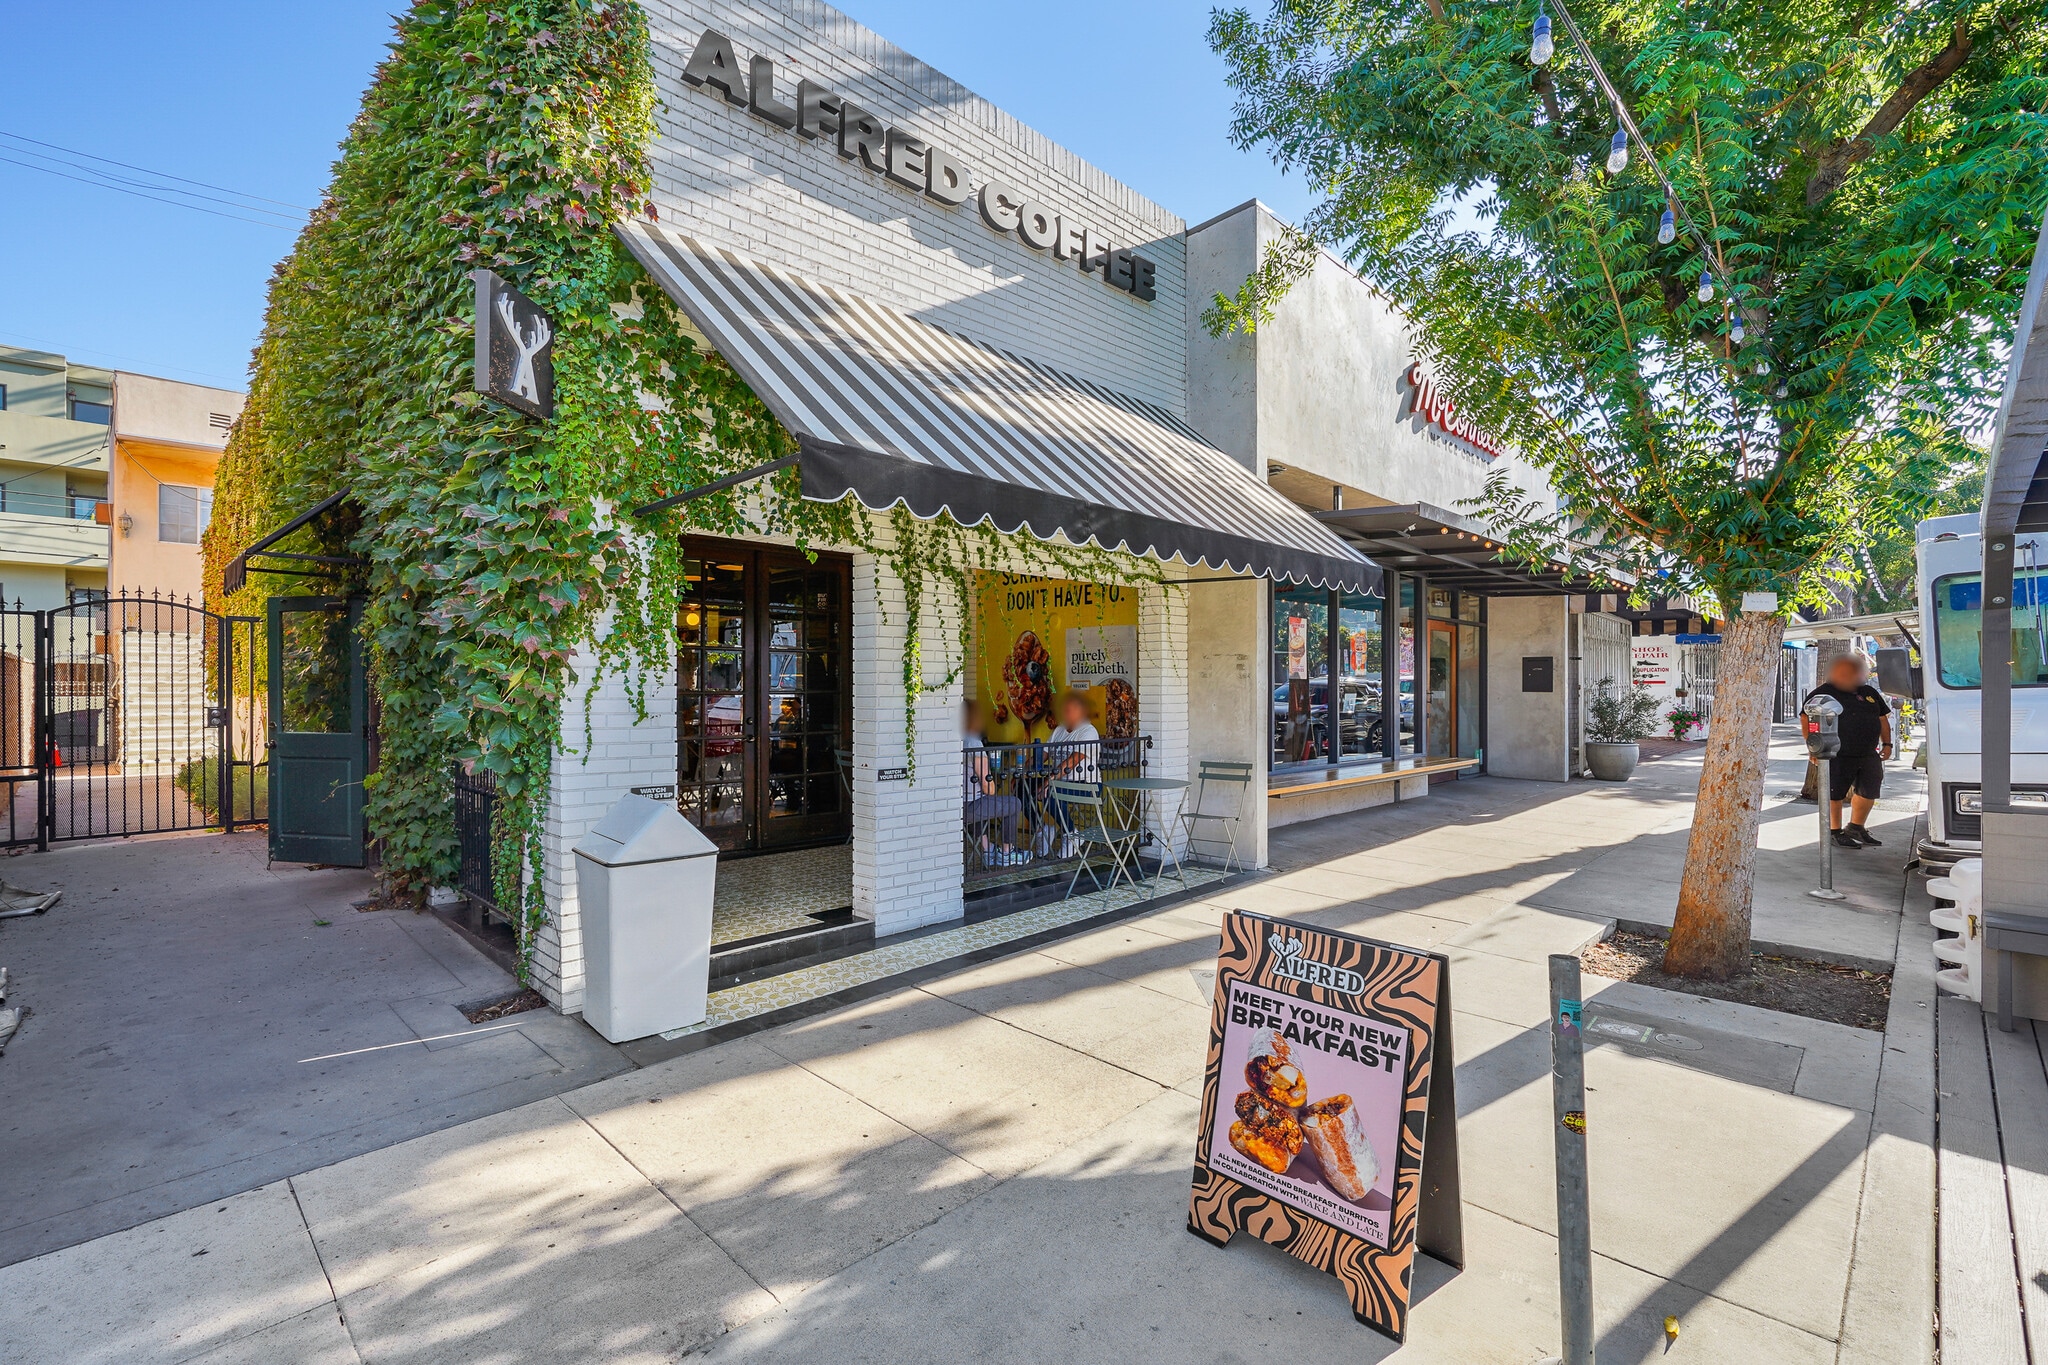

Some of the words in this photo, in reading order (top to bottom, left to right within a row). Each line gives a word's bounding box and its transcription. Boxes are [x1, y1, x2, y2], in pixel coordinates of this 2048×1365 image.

[681, 28, 971, 208] ALFRED
[978, 181, 1157, 302] COFFEE
[1421, 428, 1442, 449] FINE
[1444, 439, 1459, 456] ICE
[1007, 588, 1048, 611] DON'T
[1054, 583, 1093, 608] HAVE
[1071, 649, 1107, 665] purely
[1272, 949, 1364, 994] ALFRED
[1231, 1004, 1401, 1073] BREAKFAST
[1233, 988, 1285, 1015] MEET
[1289, 1004, 1345, 1034] YOUR
[1349, 1022, 1402, 1050] NEW
[1213, 1158, 1220, 1166] IN
[1221, 1161, 1279, 1192] COLLABORATION
[1280, 1188, 1299, 1201] WITH
[1298, 1196, 1329, 1216] WAKE
[1330, 1211, 1355, 1227] AND
[1356, 1222, 1384, 1241] LATE
[1218, 1152, 1231, 1162] ALL
[1231, 1158, 1248, 1169] NEW
[1248, 1165, 1276, 1182] BAGELS
[1276, 1177, 1293, 1189] AND
[1293, 1184, 1338, 1209] BREAKFAST
[1338, 1205, 1380, 1229] BURRITOS
